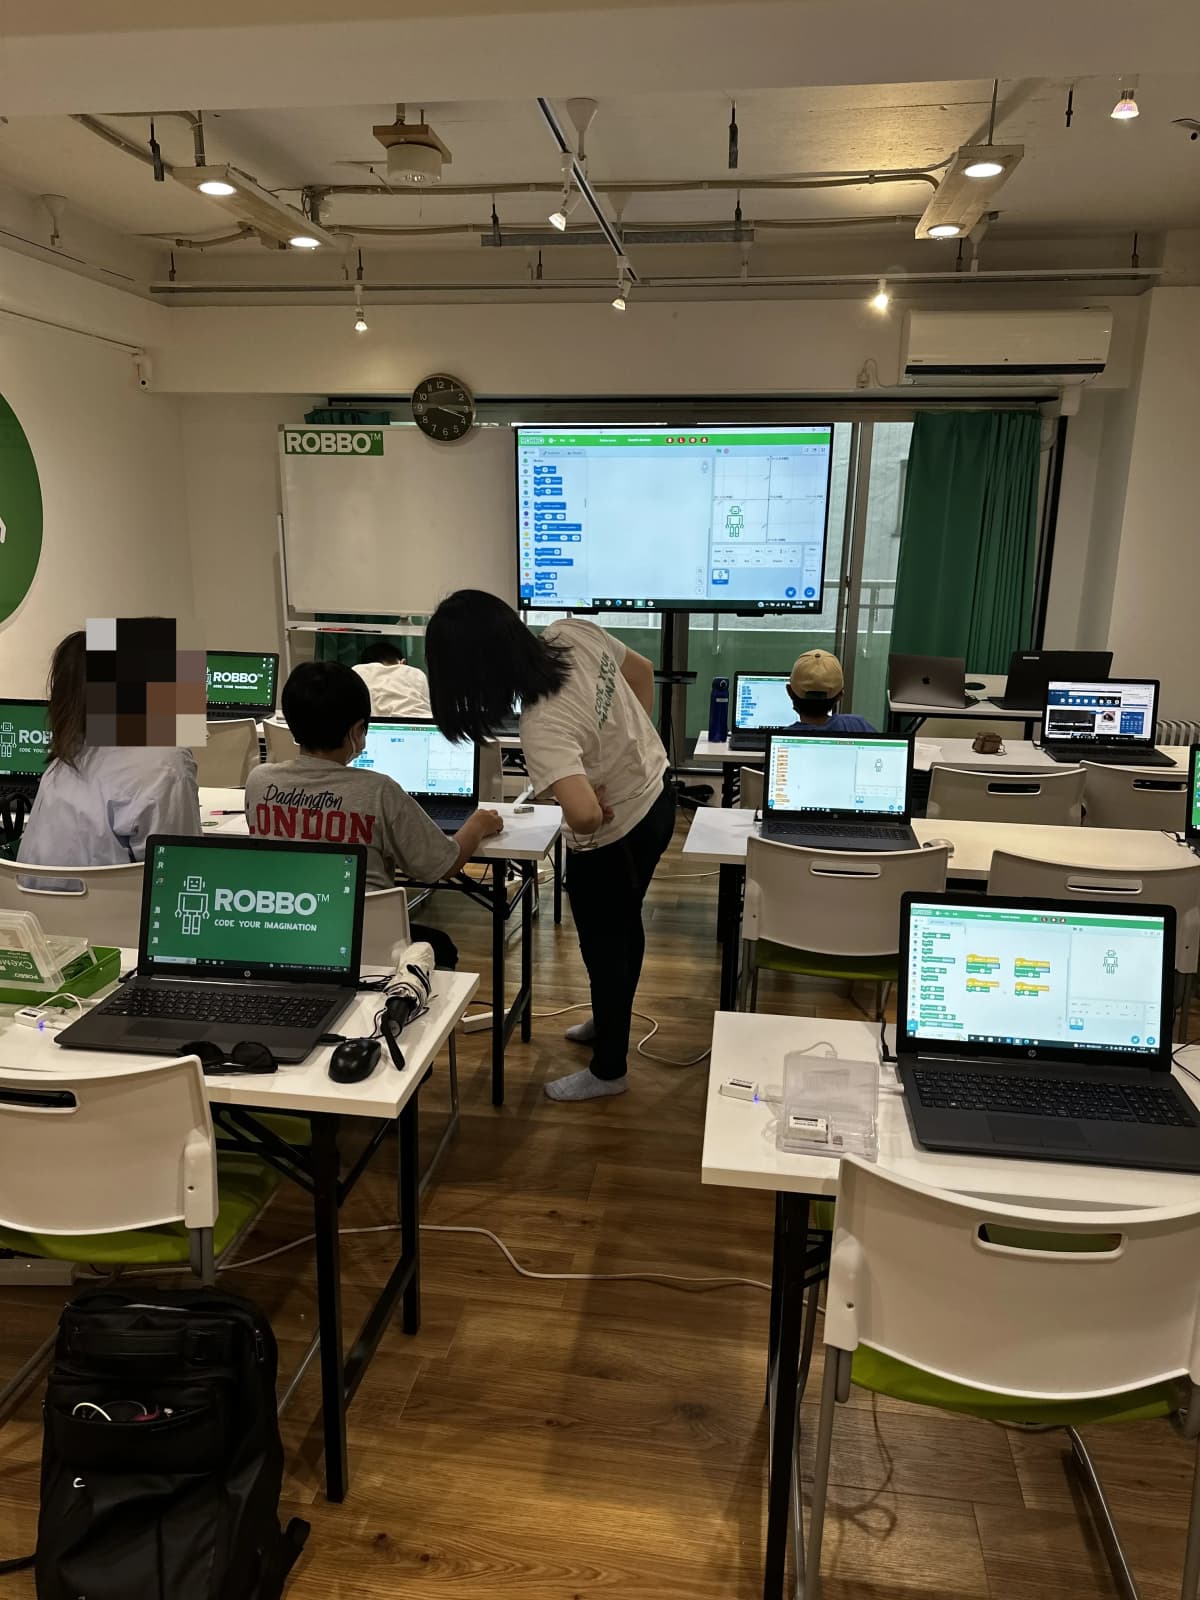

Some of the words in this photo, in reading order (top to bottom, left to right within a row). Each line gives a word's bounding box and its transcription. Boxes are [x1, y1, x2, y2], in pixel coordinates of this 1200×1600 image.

[436, 381, 446, 389] 12
[420, 393, 427, 401] 10
[458, 393, 465, 401] 2
[417, 403, 423, 412] 9
[463, 405, 469, 413] 3
[422, 415, 429, 424] 8
[431, 424, 437, 432] 7
[442, 427, 449, 436] 6
[453, 425, 459, 434] 5
[249, 803, 376, 844] ONDON
[214, 918, 235, 927] CODE
[239, 919, 261, 929] YOUR
[264, 921, 317, 932] IMAGINATION
